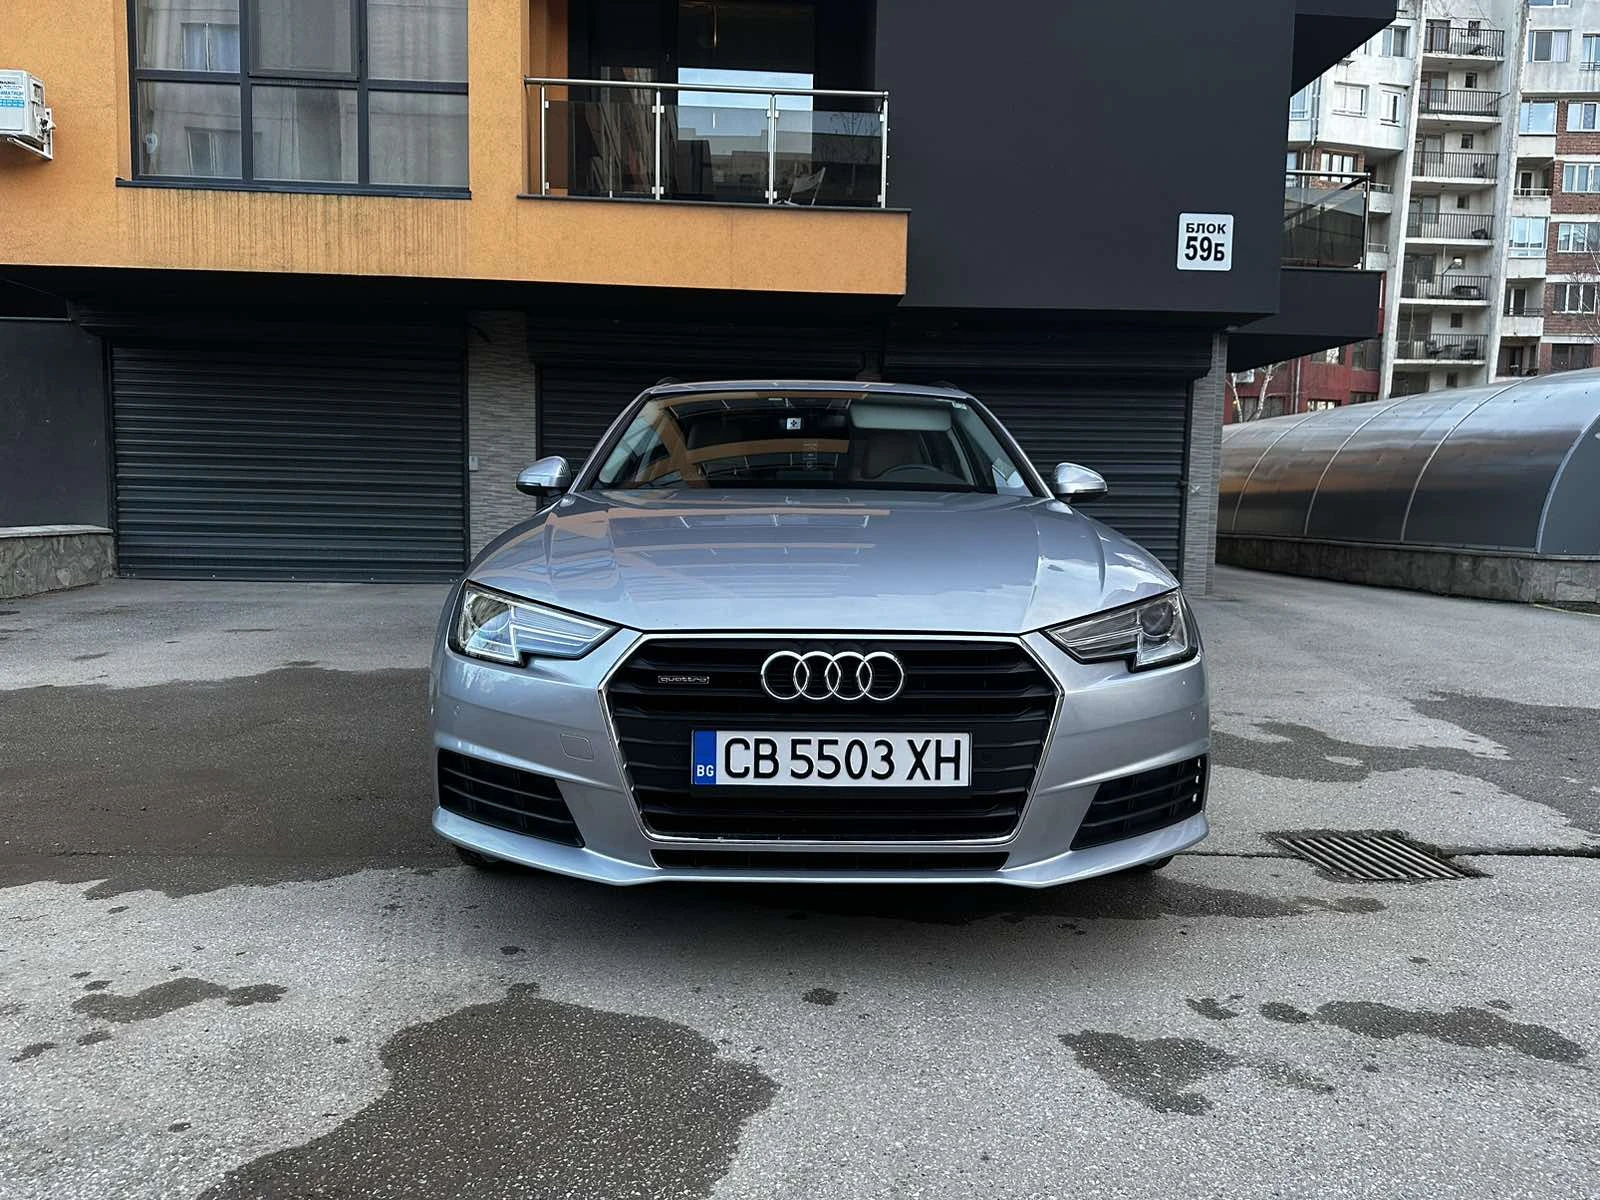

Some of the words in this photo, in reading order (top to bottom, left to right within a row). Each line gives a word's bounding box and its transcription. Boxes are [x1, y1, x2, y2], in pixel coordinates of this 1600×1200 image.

[1186, 223, 1226, 234] БЛОК
[1185, 236, 1225, 261] 59Б
[724, 737, 779, 779] CB
[790, 738, 895, 779] 5503
[905, 739, 961, 781] XH
[696, 765, 715, 777] BG
